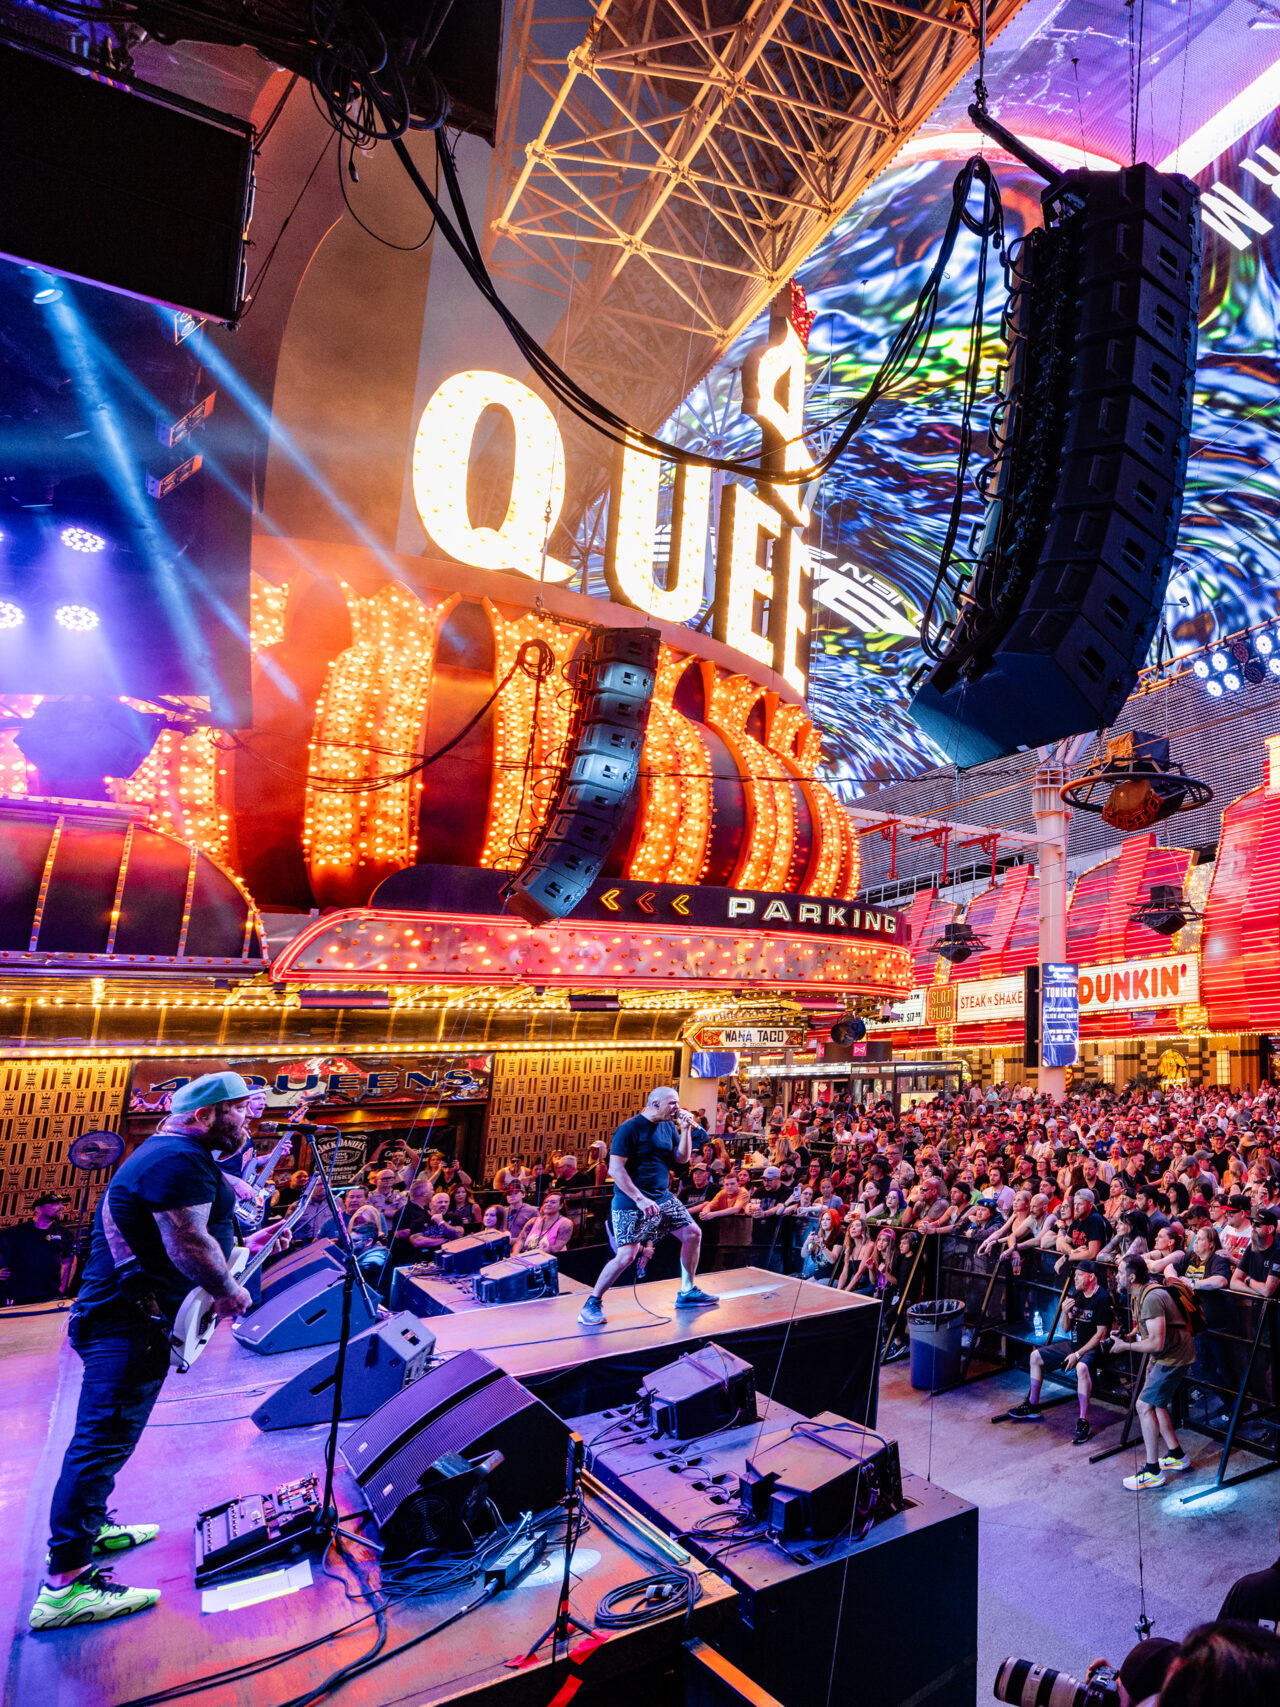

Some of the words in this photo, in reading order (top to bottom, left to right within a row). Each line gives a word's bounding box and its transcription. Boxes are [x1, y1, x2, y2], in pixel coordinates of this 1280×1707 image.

[728, 896, 896, 935] PARKING
[1045, 986, 1077, 998] TONIGHT
[1078, 963, 1187, 1005] DUNKIN'
[931, 989, 951, 1005] SLOT
[960, 995, 986, 1010] STEAK
[993, 990, 1024, 1006] SHAKE
[930, 1005, 951, 1020] CLUB
[725, 1029, 753, 1042] WANA
[757, 1029, 784, 1042] TACO
